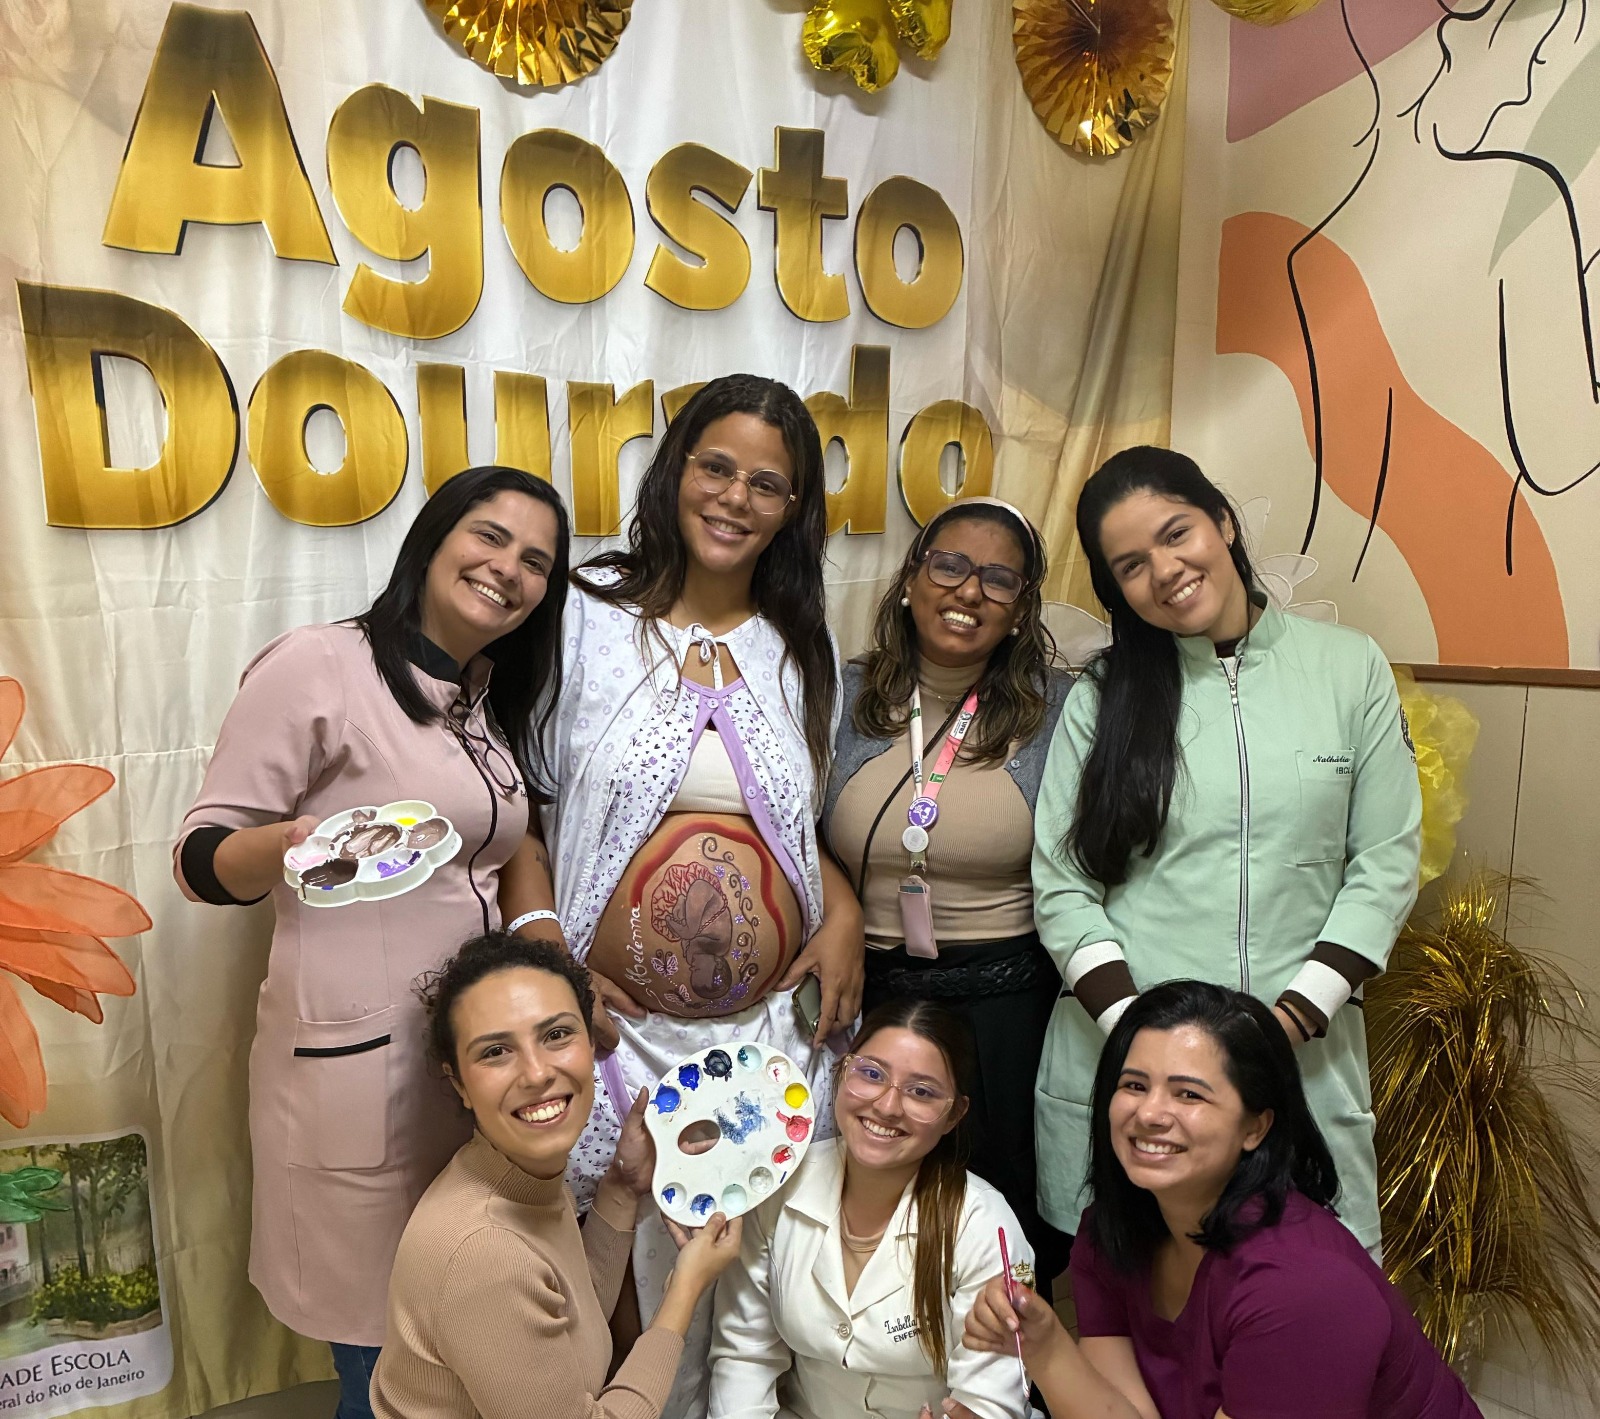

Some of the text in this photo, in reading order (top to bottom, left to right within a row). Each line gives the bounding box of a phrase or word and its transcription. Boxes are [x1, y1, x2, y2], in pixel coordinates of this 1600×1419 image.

[101, 2, 965, 340] Agosto
[14, 278, 994, 533] Dourdo
[25, 1390, 45, 1405] do
[49, 1382, 71, 1398] Rio
[75, 1376, 93, 1390] de
[97, 1369, 145, 1389] Janeiro
[893, 1328, 920, 1342] ENFER
